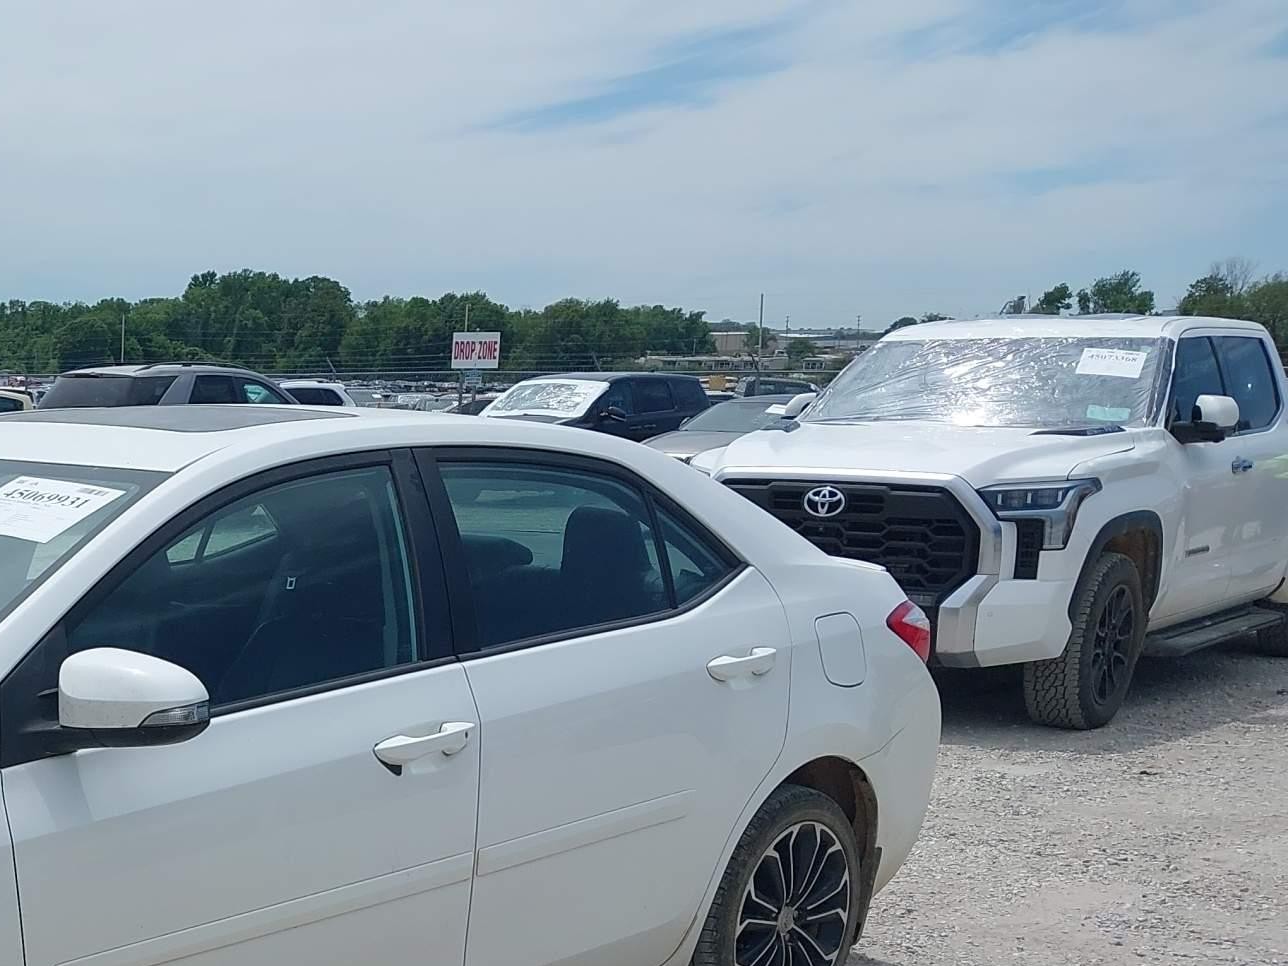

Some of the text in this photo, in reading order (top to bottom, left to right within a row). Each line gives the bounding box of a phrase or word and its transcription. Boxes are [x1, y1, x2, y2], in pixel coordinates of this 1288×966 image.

[454, 340, 498, 360] DROP ZONE
[3, 488, 91, 509] 45069931
